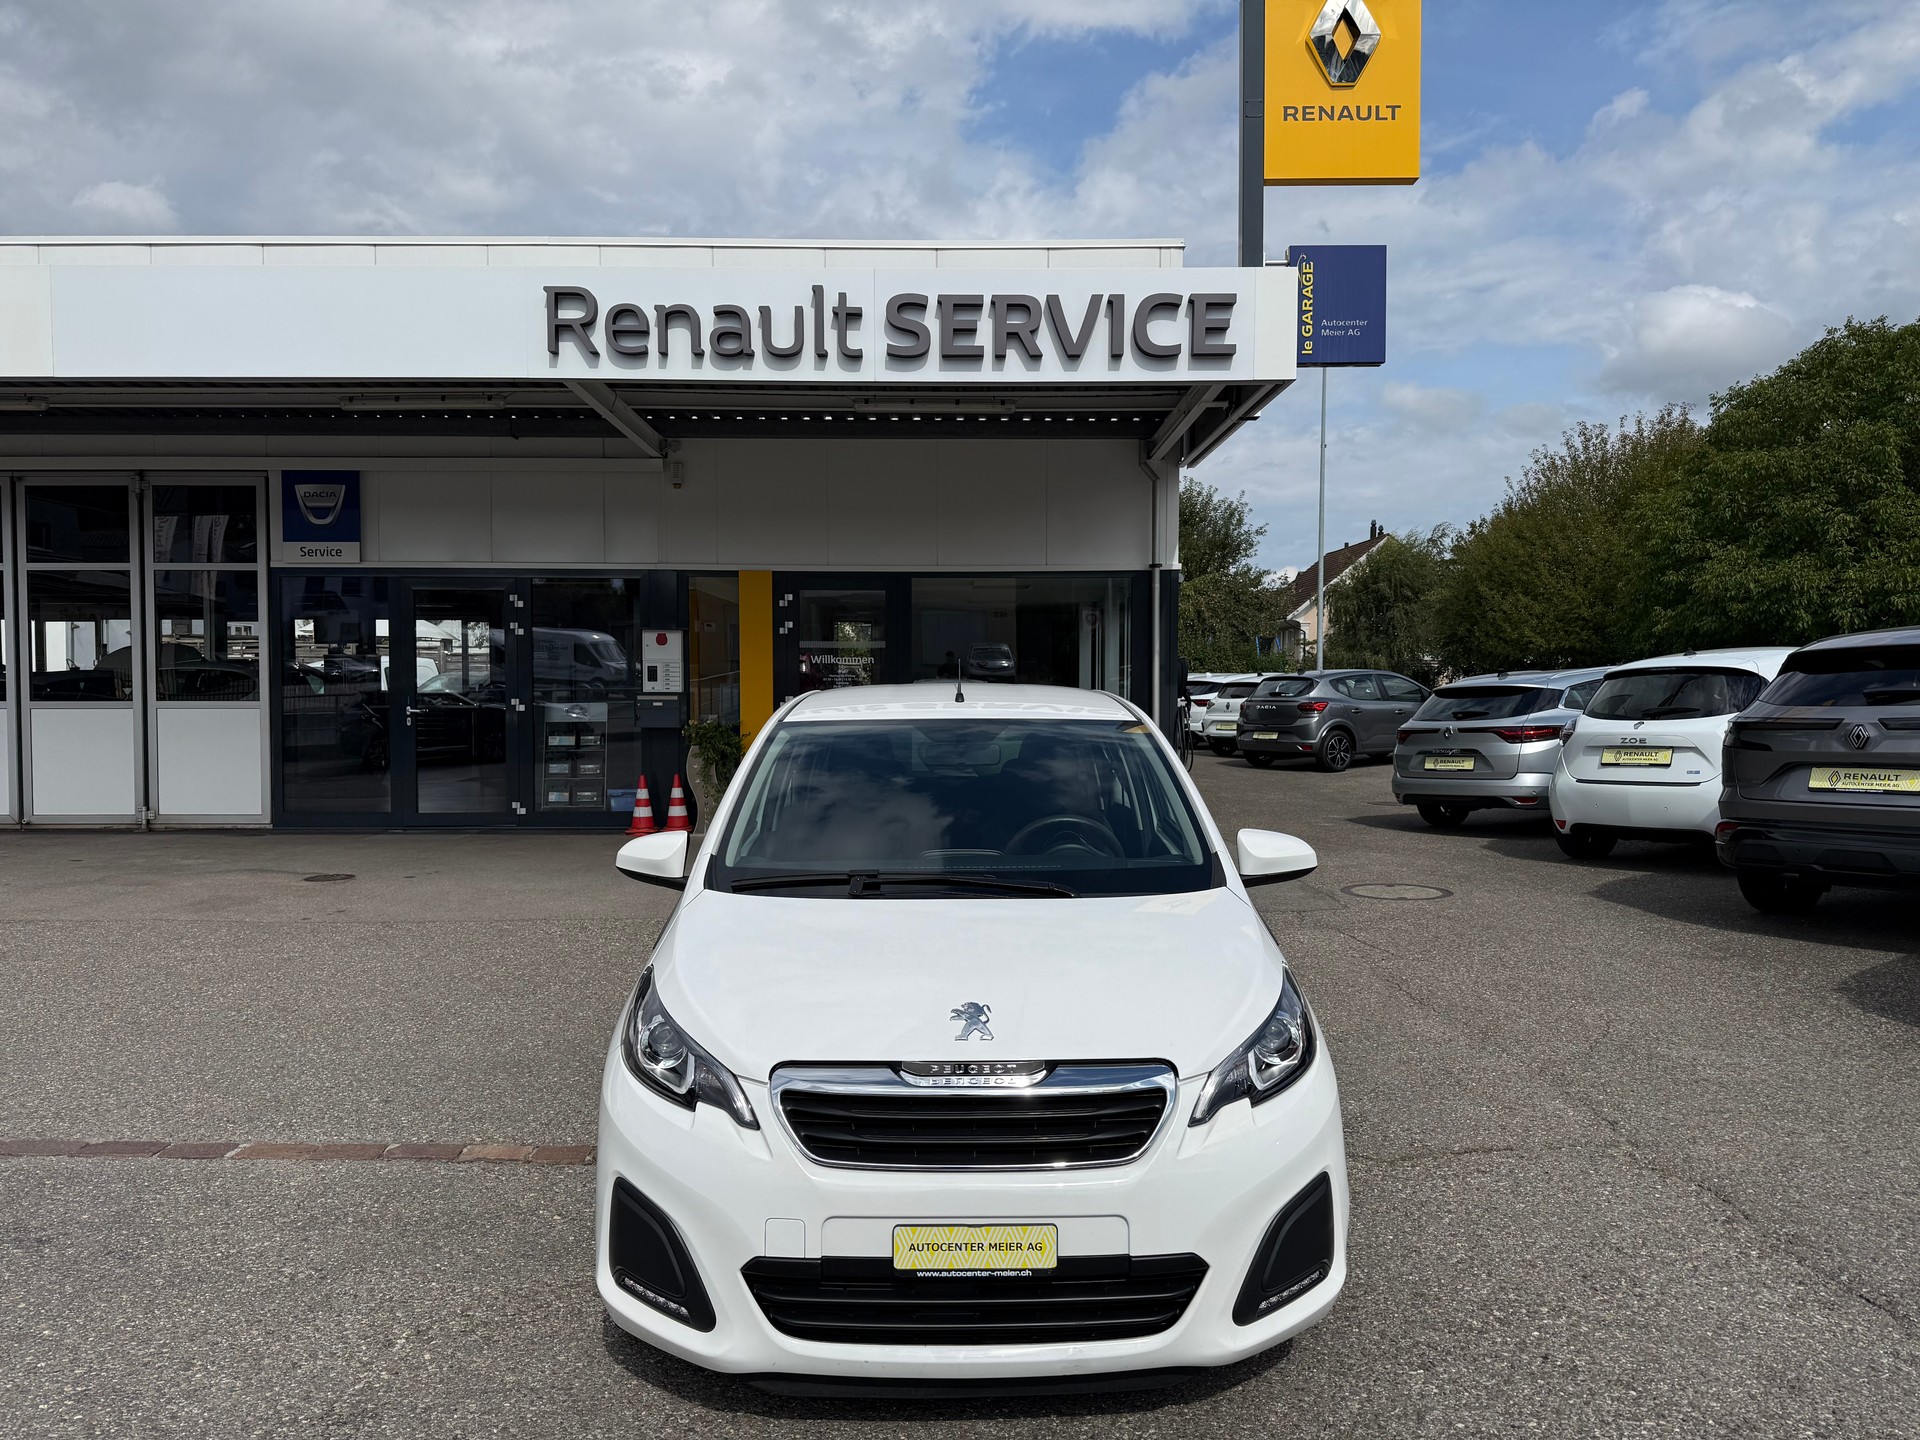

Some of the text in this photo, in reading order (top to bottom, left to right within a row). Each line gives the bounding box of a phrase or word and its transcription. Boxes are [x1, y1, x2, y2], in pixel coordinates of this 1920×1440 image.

[1282, 105, 1402, 122] RENAULT
[1301, 261, 1314, 355] le GARAGE
[543, 284, 1237, 359] Renault SERVICE
[1321, 319, 1368, 327] Autocenter
[299, 546, 342, 557] Service
[810, 654, 875, 664] Willkommen
[1620, 737, 1648, 745] ZOE
[1843, 773, 1902, 782] RENAULT
[930, 1064, 1017, 1074] PEUGEOT
[908, 1242, 1043, 1252] AUTOCENTER MEIER AG
[916, 1269, 1032, 1278] www.autocenter-meier.ch
